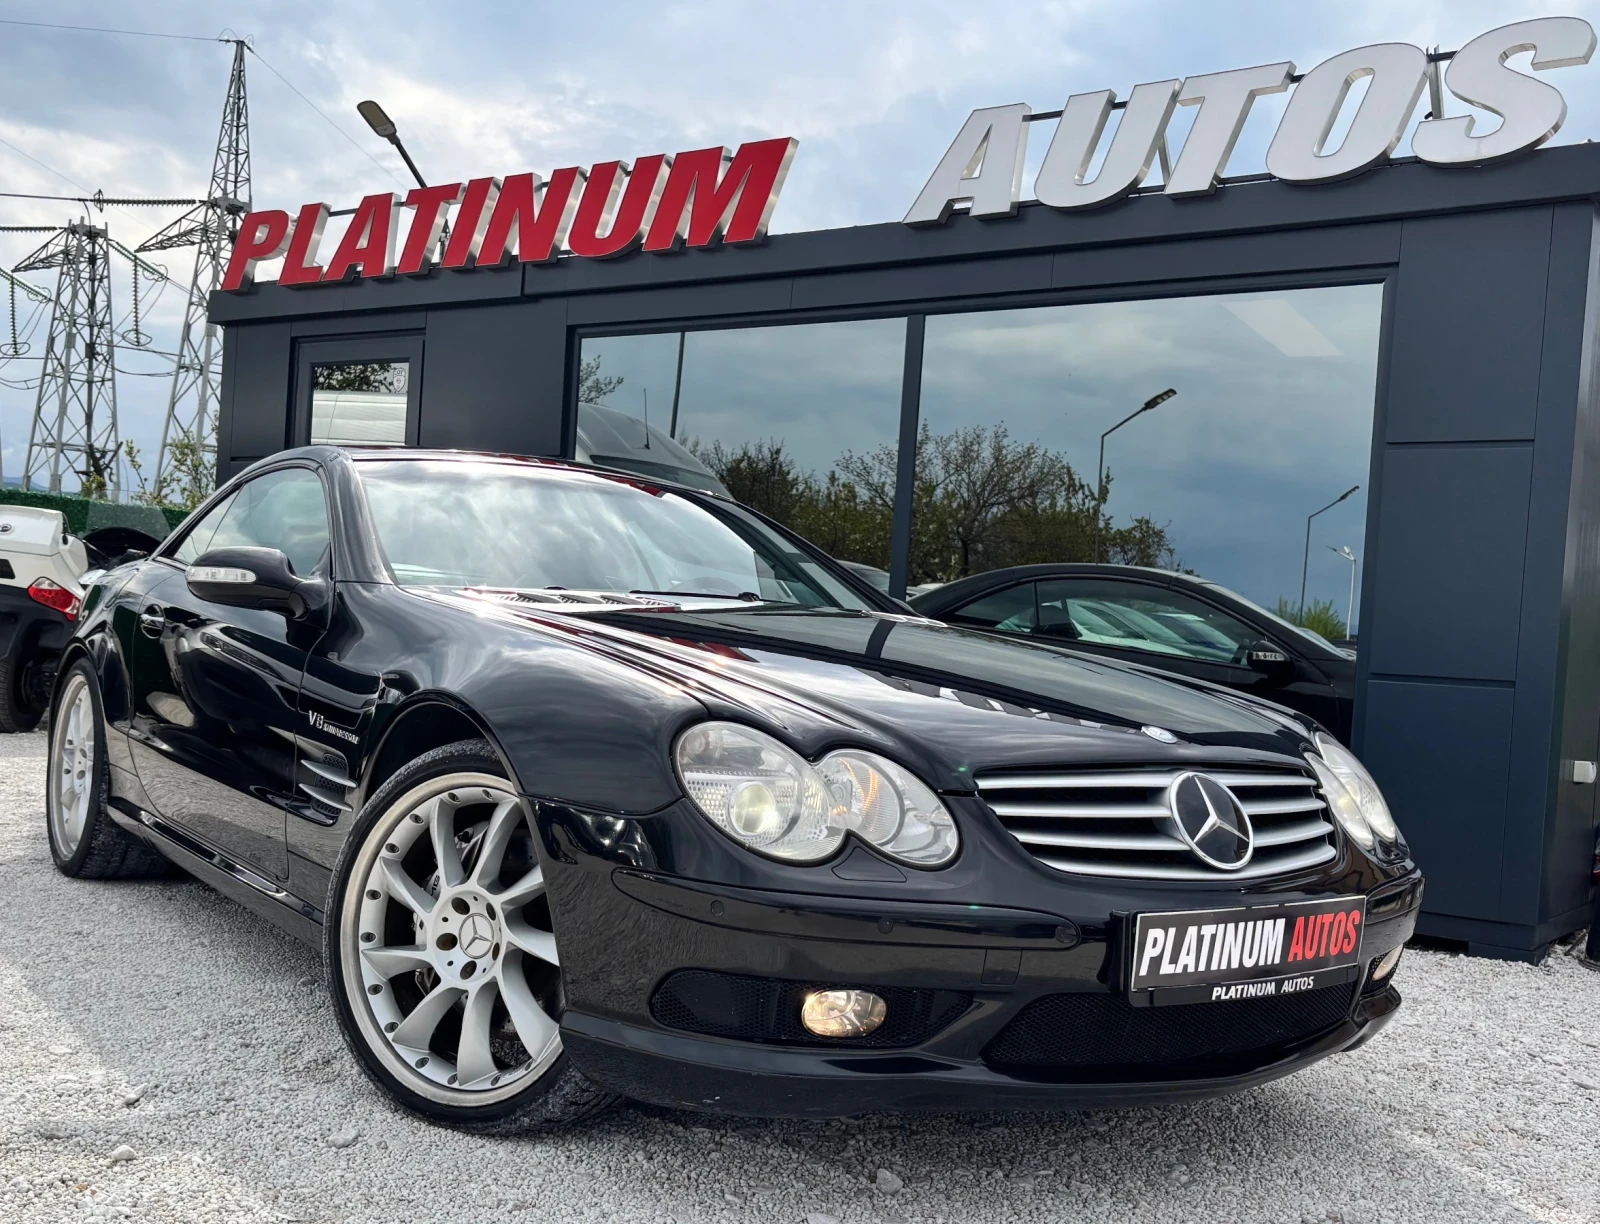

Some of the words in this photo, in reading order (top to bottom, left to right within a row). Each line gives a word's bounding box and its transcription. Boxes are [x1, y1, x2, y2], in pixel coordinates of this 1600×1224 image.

[221, 137, 798, 292] PLATINUM
[901, 16, 1597, 227] AUTOS
[1139, 918, 1286, 976] PLATINUM
[1288, 910, 1361, 962] AUTOS
[1212, 981, 1275, 1000] PLATINUM
[1281, 976, 1314, 992] AUTOS
